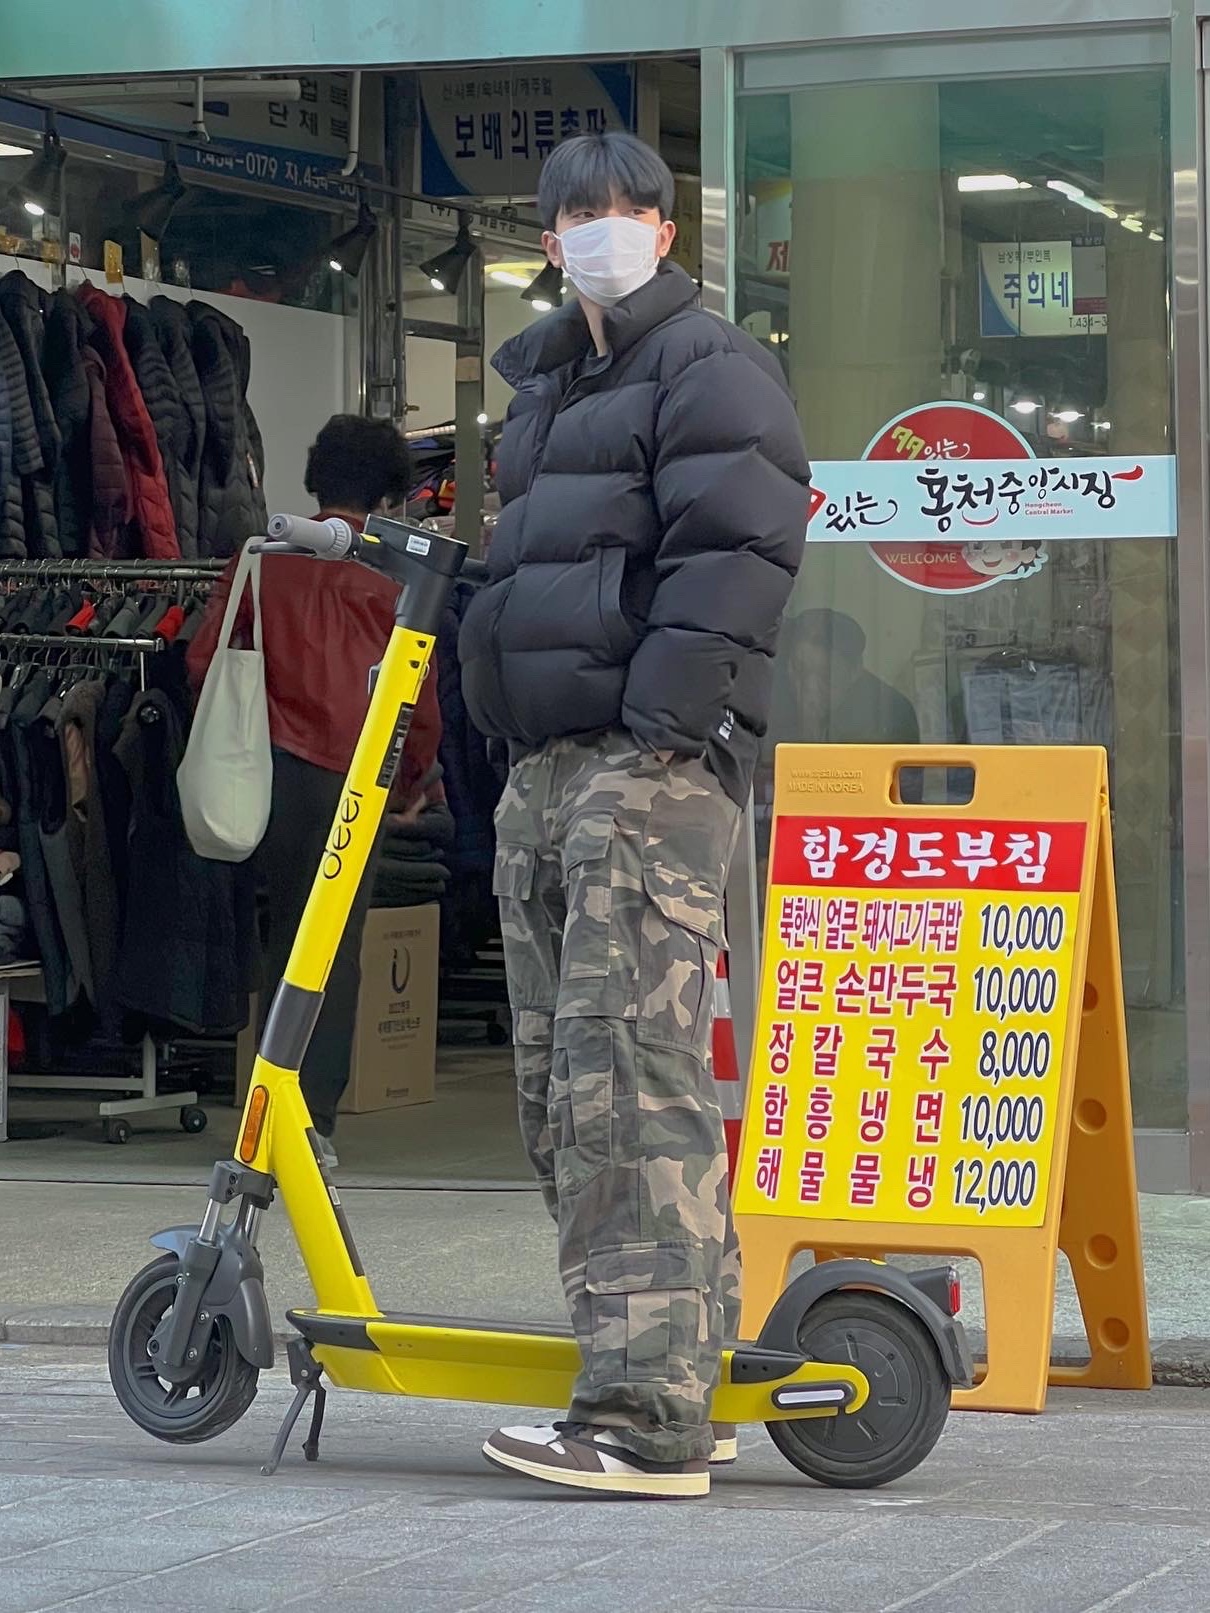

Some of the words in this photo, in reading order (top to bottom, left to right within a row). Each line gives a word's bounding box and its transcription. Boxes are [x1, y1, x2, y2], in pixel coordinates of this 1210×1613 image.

[1003, 272, 1069, 309] 주희네
[917, 465, 1144, 533] 홍천중앙시장
[885, 552, 958, 565] WELCOME
[787, 780, 814, 793] MADE
[827, 781, 865, 794] KOREA
[801, 826, 1052, 884] 함경도부침
[780, 897, 821, 950] 북한식
[825, 898, 858, 950] 얼큰
[862, 900, 962, 952] 돼지고기국밥
[981, 904, 1064, 957] 10,000
[777, 960, 824, 1011] 얼큰
[835, 964, 957, 1016] 손만두국
[974, 967, 1056, 1020] 10,000
[979, 1031, 1050, 1085] 8,000
[962, 1095, 1043, 1149] 10,000
[954, 1160, 1036, 1213] 12,000
